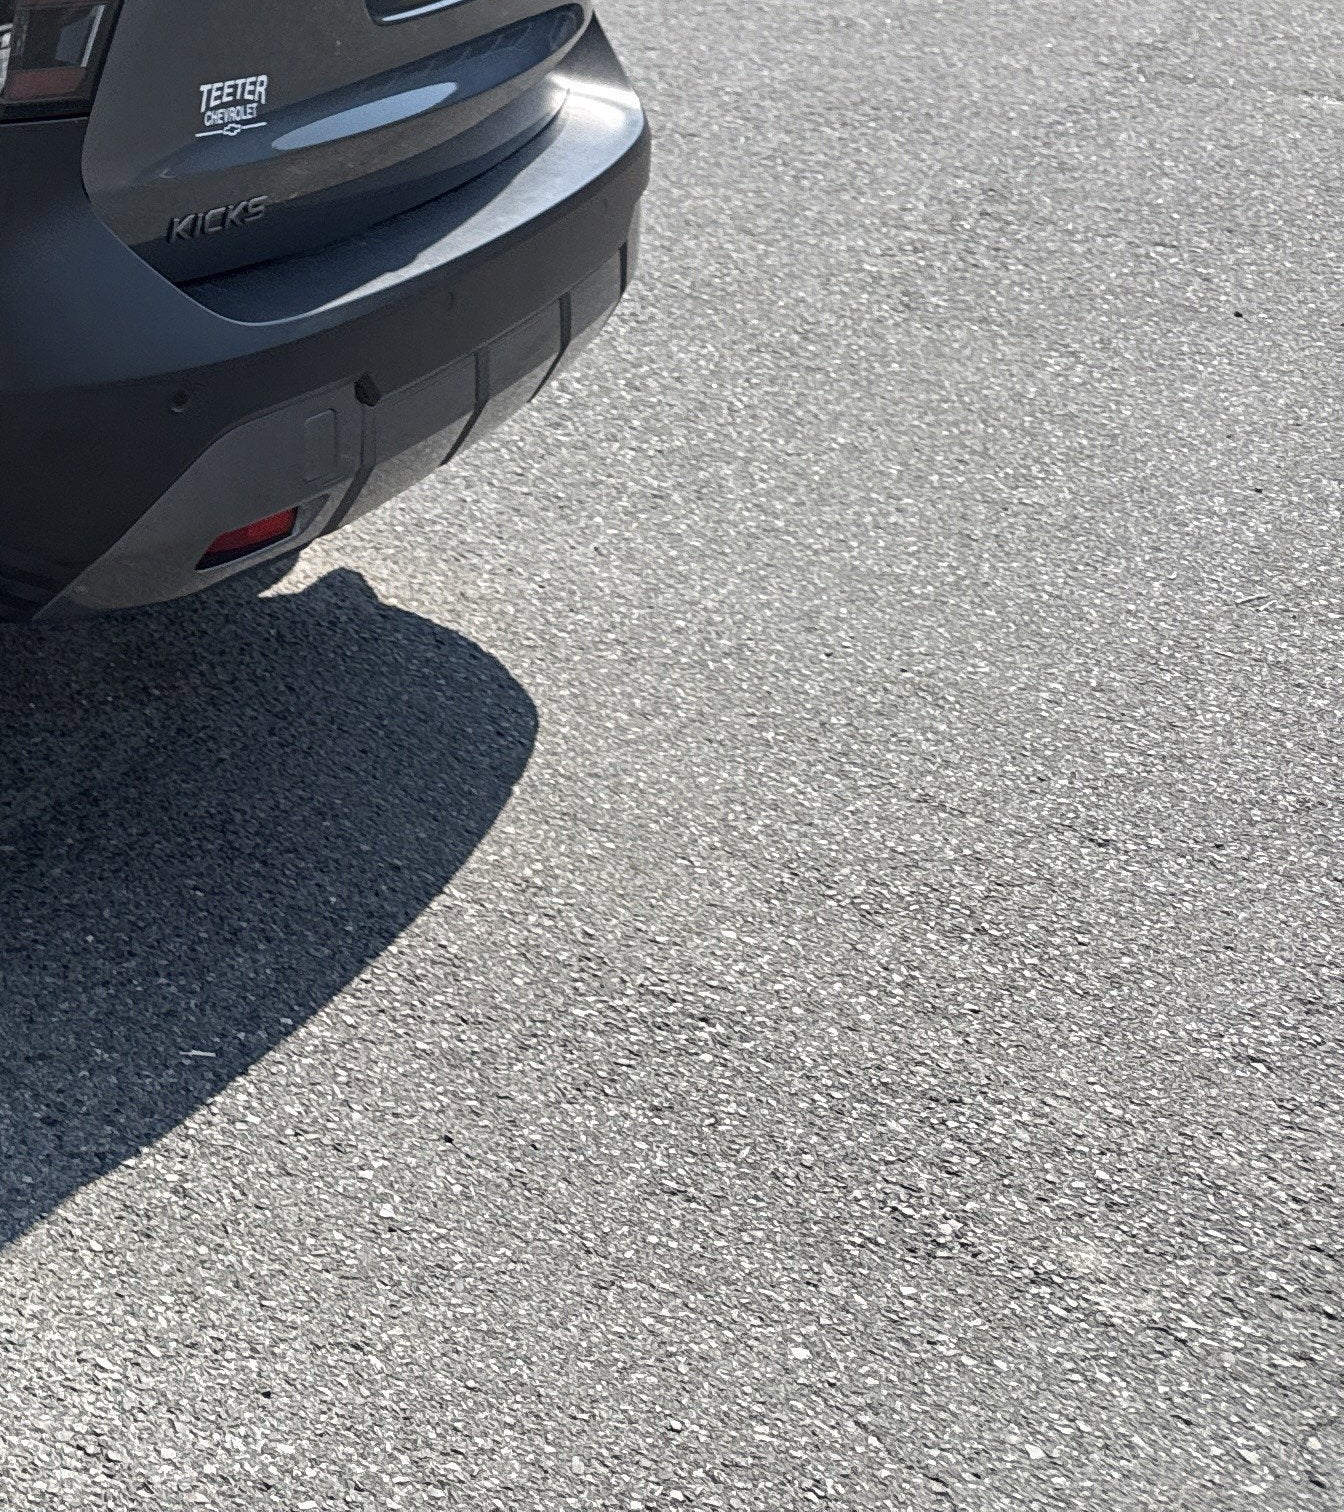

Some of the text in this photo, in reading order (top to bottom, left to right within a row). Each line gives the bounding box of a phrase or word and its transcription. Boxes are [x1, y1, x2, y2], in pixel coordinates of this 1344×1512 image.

[199, 74, 268, 114] TEETER
[204, 103, 258, 126] CHEVROLET
[166, 195, 268, 243] KICKS
